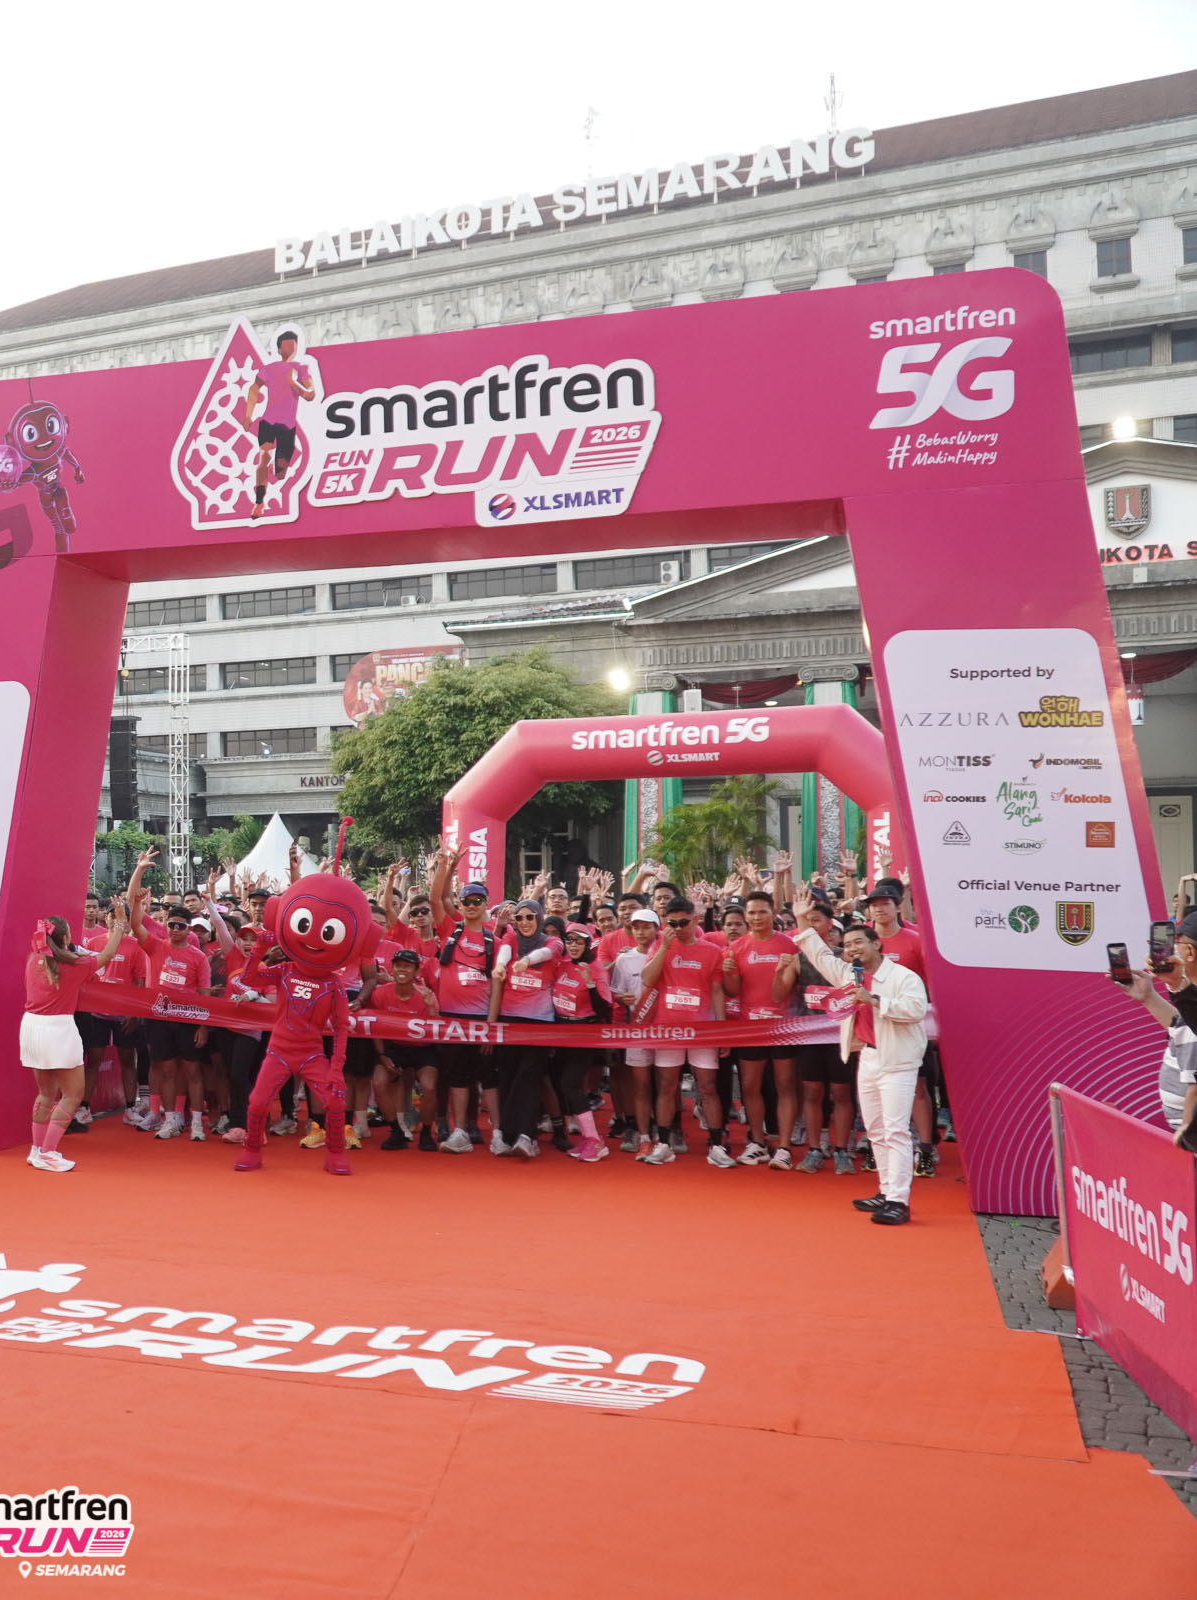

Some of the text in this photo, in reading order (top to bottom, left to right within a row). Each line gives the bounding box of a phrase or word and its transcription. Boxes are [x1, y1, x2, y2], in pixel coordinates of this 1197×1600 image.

[552, 126, 876, 223] SEMARANG
[869, 305, 1016, 340] smartfren
[869, 336, 1015, 430] 5G
[325, 363, 645, 440] smartfren
[590, 425, 642, 444] 2026
[916, 431, 999, 449] BebasWorry
[323, 448, 375, 470] FUN
[368, 428, 579, 494] RUN
[912, 450, 998, 467] MakinHappy
[321, 473, 359, 494] 5K
[523, 488, 625, 513] XLSMART
[376, 662, 433, 687] PANC
[949, 666, 1055, 681] Supported by
[900, 712, 1010, 727] AZZURA
[1019, 711, 1103, 728] WONHAE
[572, 716, 770, 750] smartfren 5G
[666, 752, 720, 763] XLSMART
[919, 755, 992, 767] MONTISS
[1046, 758, 1103, 766] INDOMOBIL
[300, 775, 346, 788] KANTOR
[945, 795, 987, 803] COOKIES
[996, 781, 1038, 810] Alang
[1064, 794, 1112, 804] Kokola
[1003, 801, 1031, 821] Sari
[958, 880, 1121, 892] Official Venue Partner
[975, 914, 1007, 928] park
[290, 977, 320, 989] smartfren
[292, 986, 313, 1000] 5G
[407, 1017, 510, 1043] START
[602, 1024, 696, 1039] smartfren
[1071, 1165, 1194, 1286] smartfren 5G
[1130, 1276, 1166, 1324] XLSMART
[2, 1317, 115, 1334] FUN
[41, 1299, 707, 1383] smartfren
[62, 1328, 531, 1392] RUN
[552, 1377, 677, 1395] 2026
